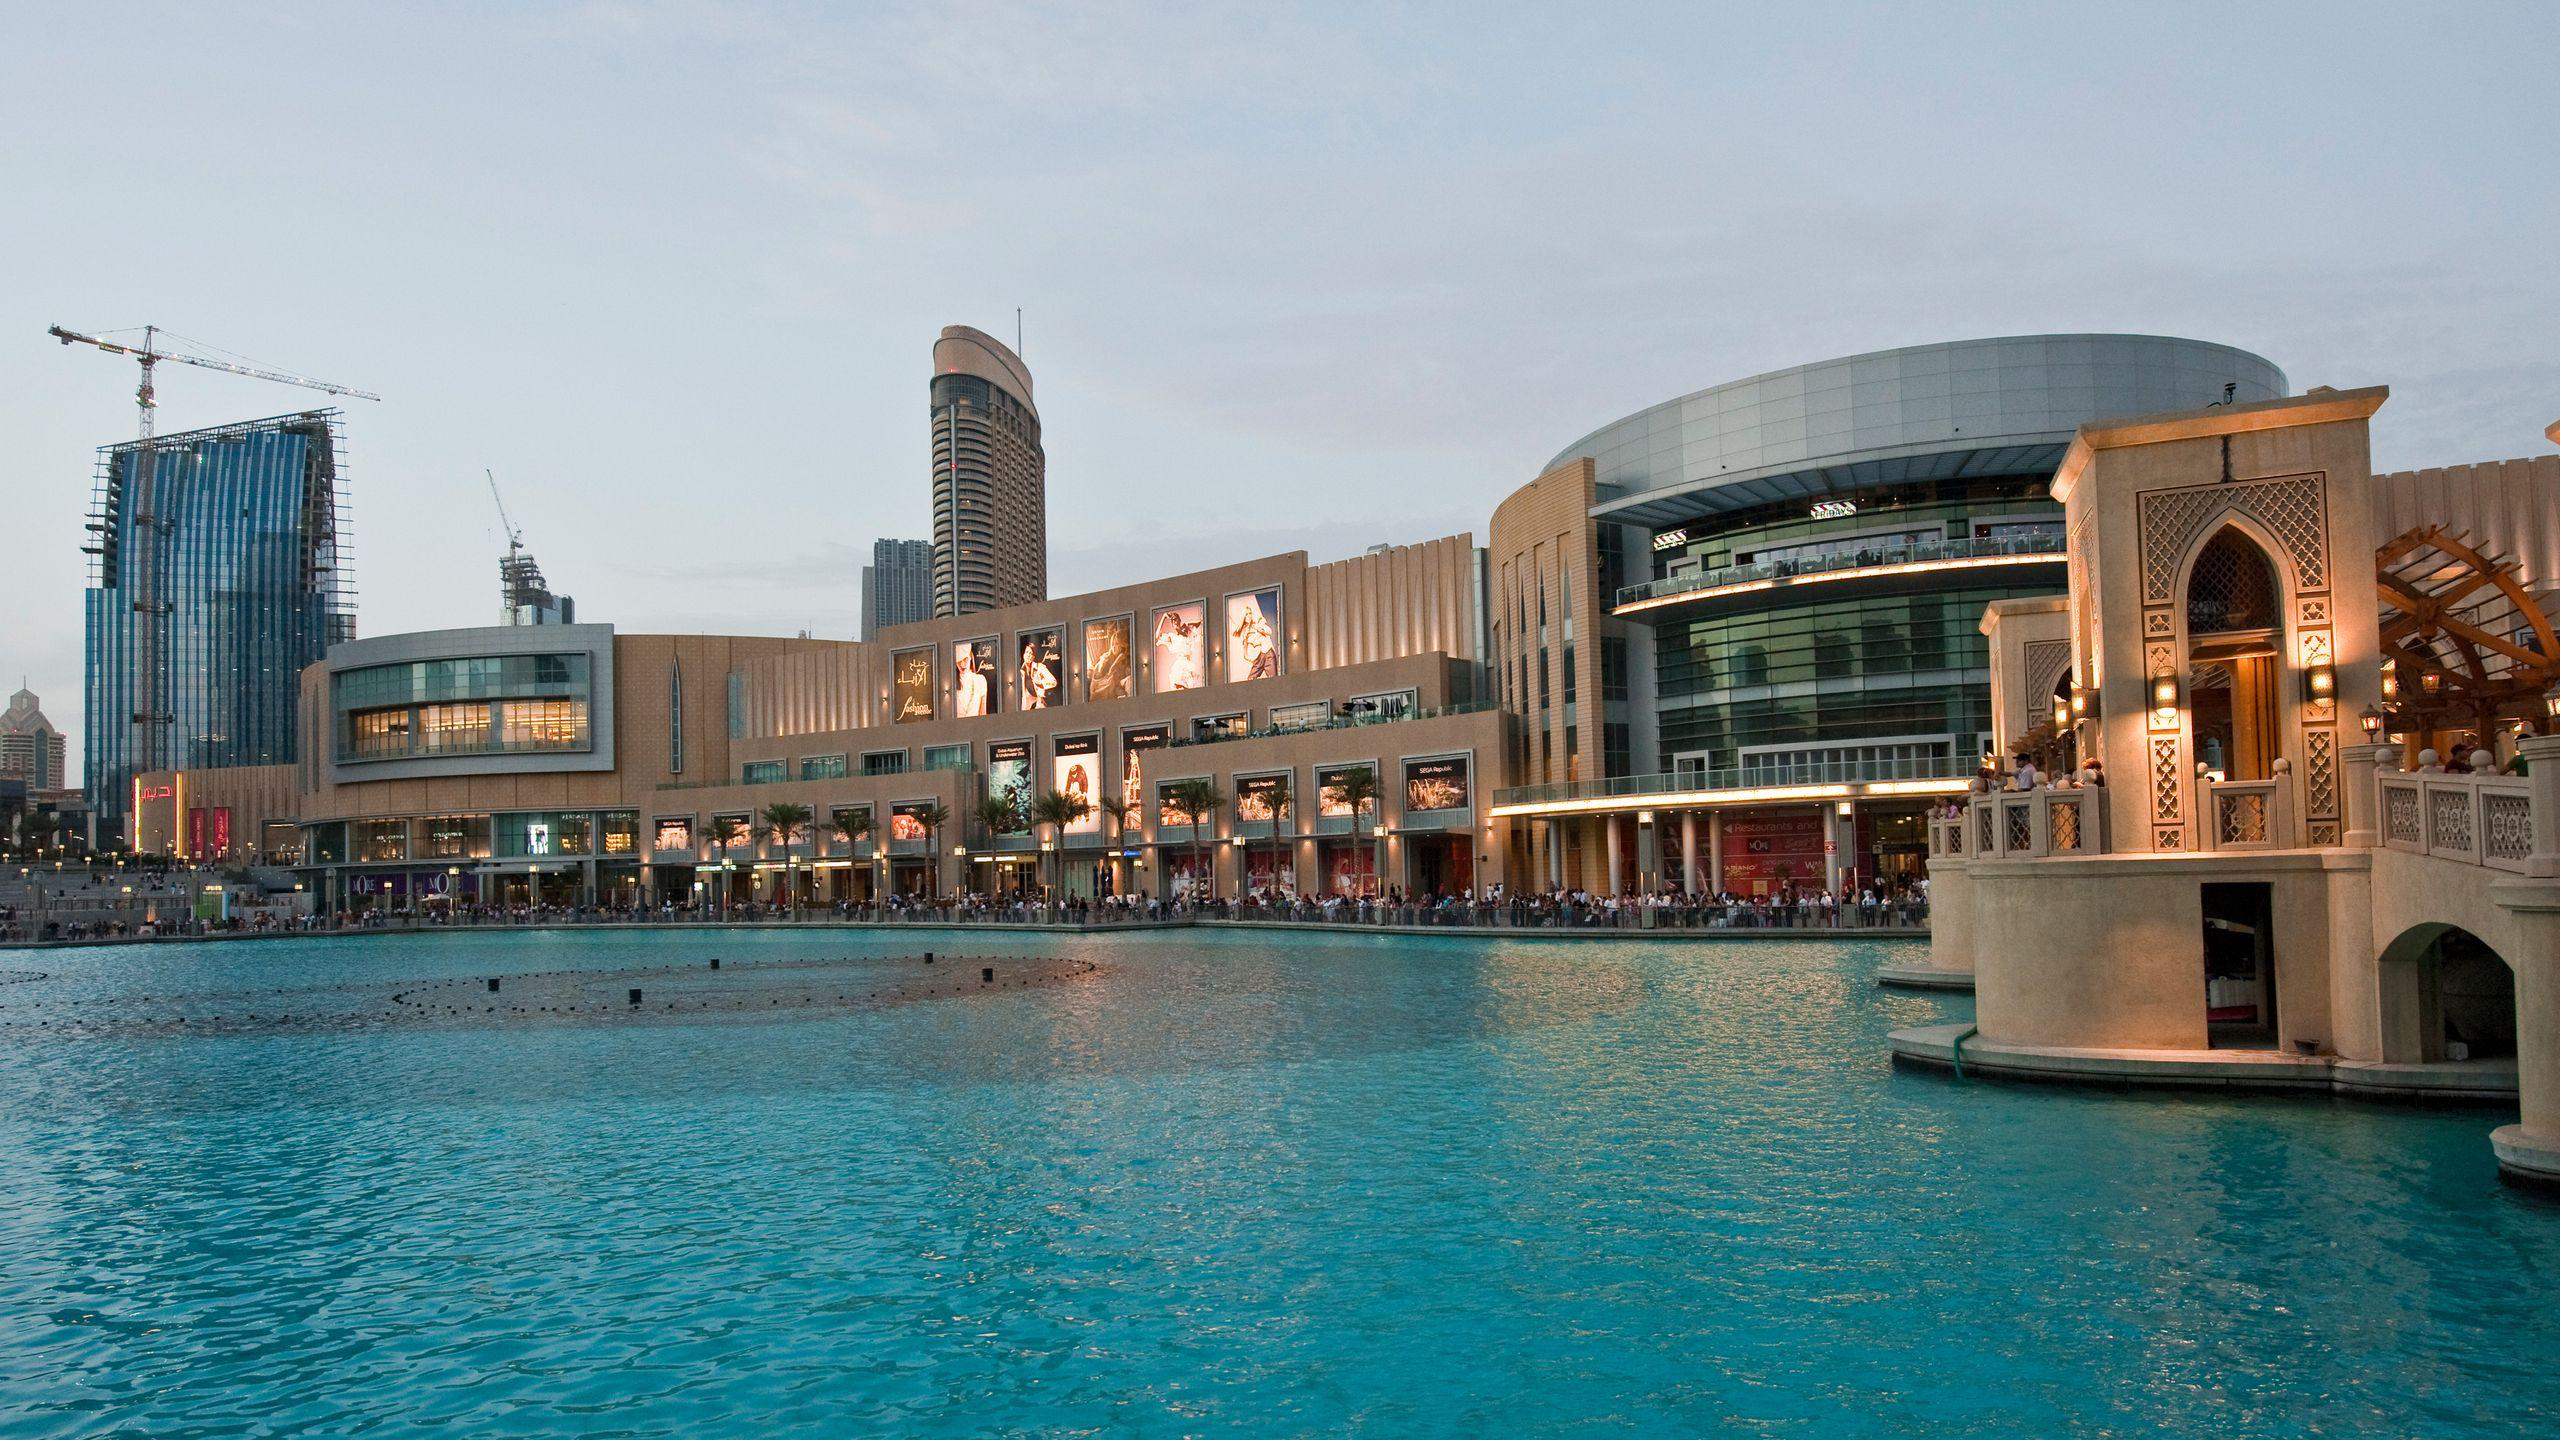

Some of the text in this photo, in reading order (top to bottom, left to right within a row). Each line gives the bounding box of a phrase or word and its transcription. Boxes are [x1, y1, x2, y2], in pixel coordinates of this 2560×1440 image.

[896, 696, 929, 720] fashion
[1433, 765, 1453, 773] Republic
[142, 786, 172, 801] دبي
[1735, 821, 1817, 832] Restaurants and
[353, 875, 375, 895] MORE
[429, 872, 461, 894] MOE
